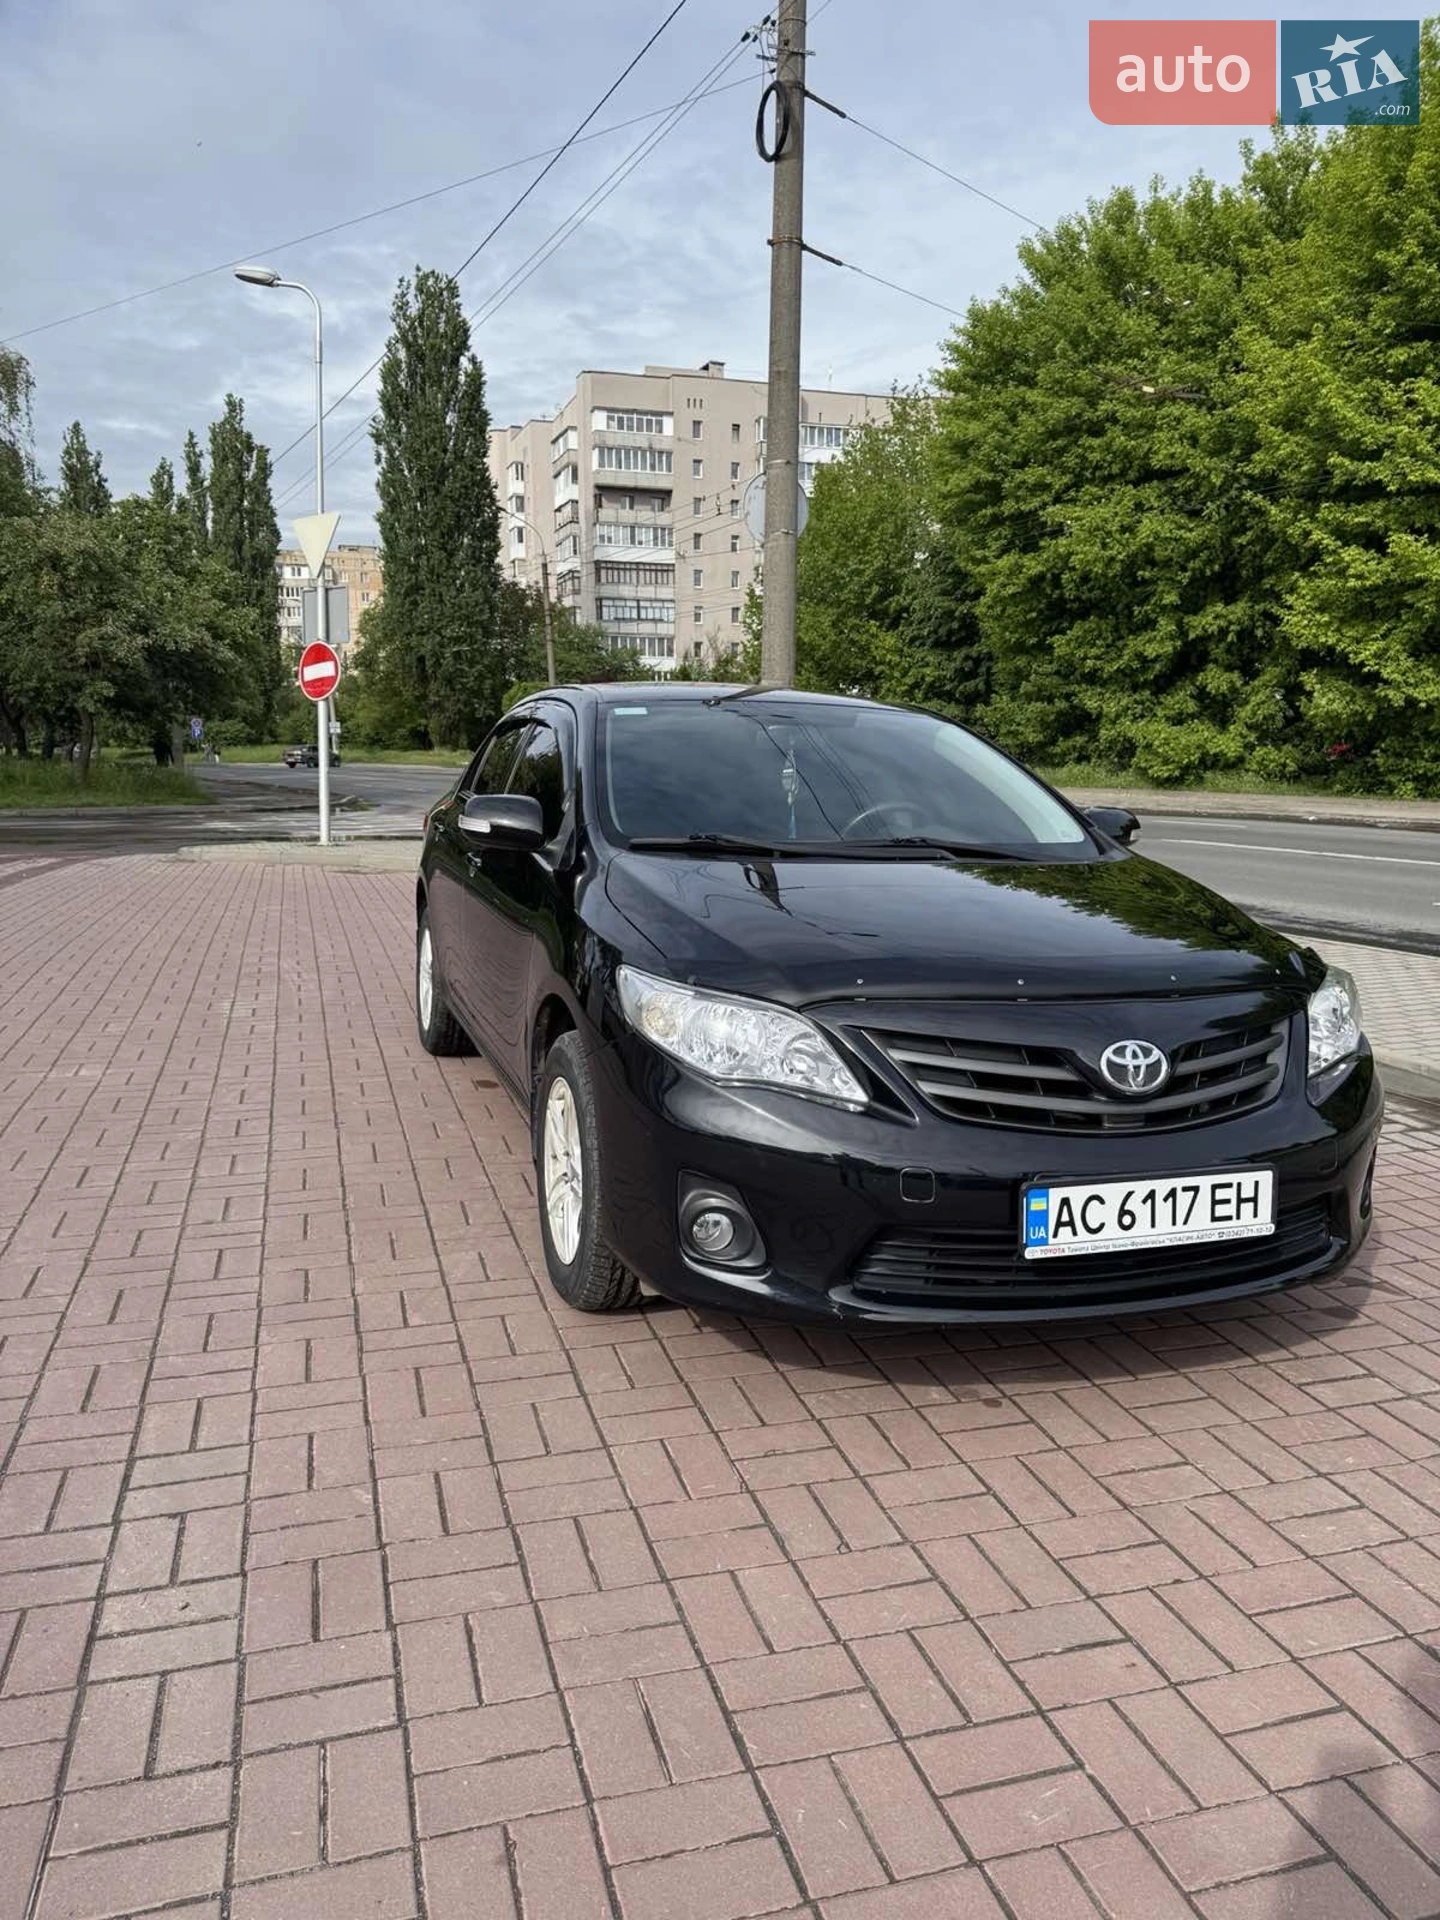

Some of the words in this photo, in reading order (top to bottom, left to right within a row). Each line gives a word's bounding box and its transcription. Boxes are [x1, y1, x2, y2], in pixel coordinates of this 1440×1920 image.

[1052, 1194, 1106, 1239] AC
[1117, 1185, 1200, 1232] 6117
[1210, 1180, 1260, 1223] EH
[1030, 1227, 1047, 1239] UA
[1039, 1247, 1066, 1256] TOYOTA
